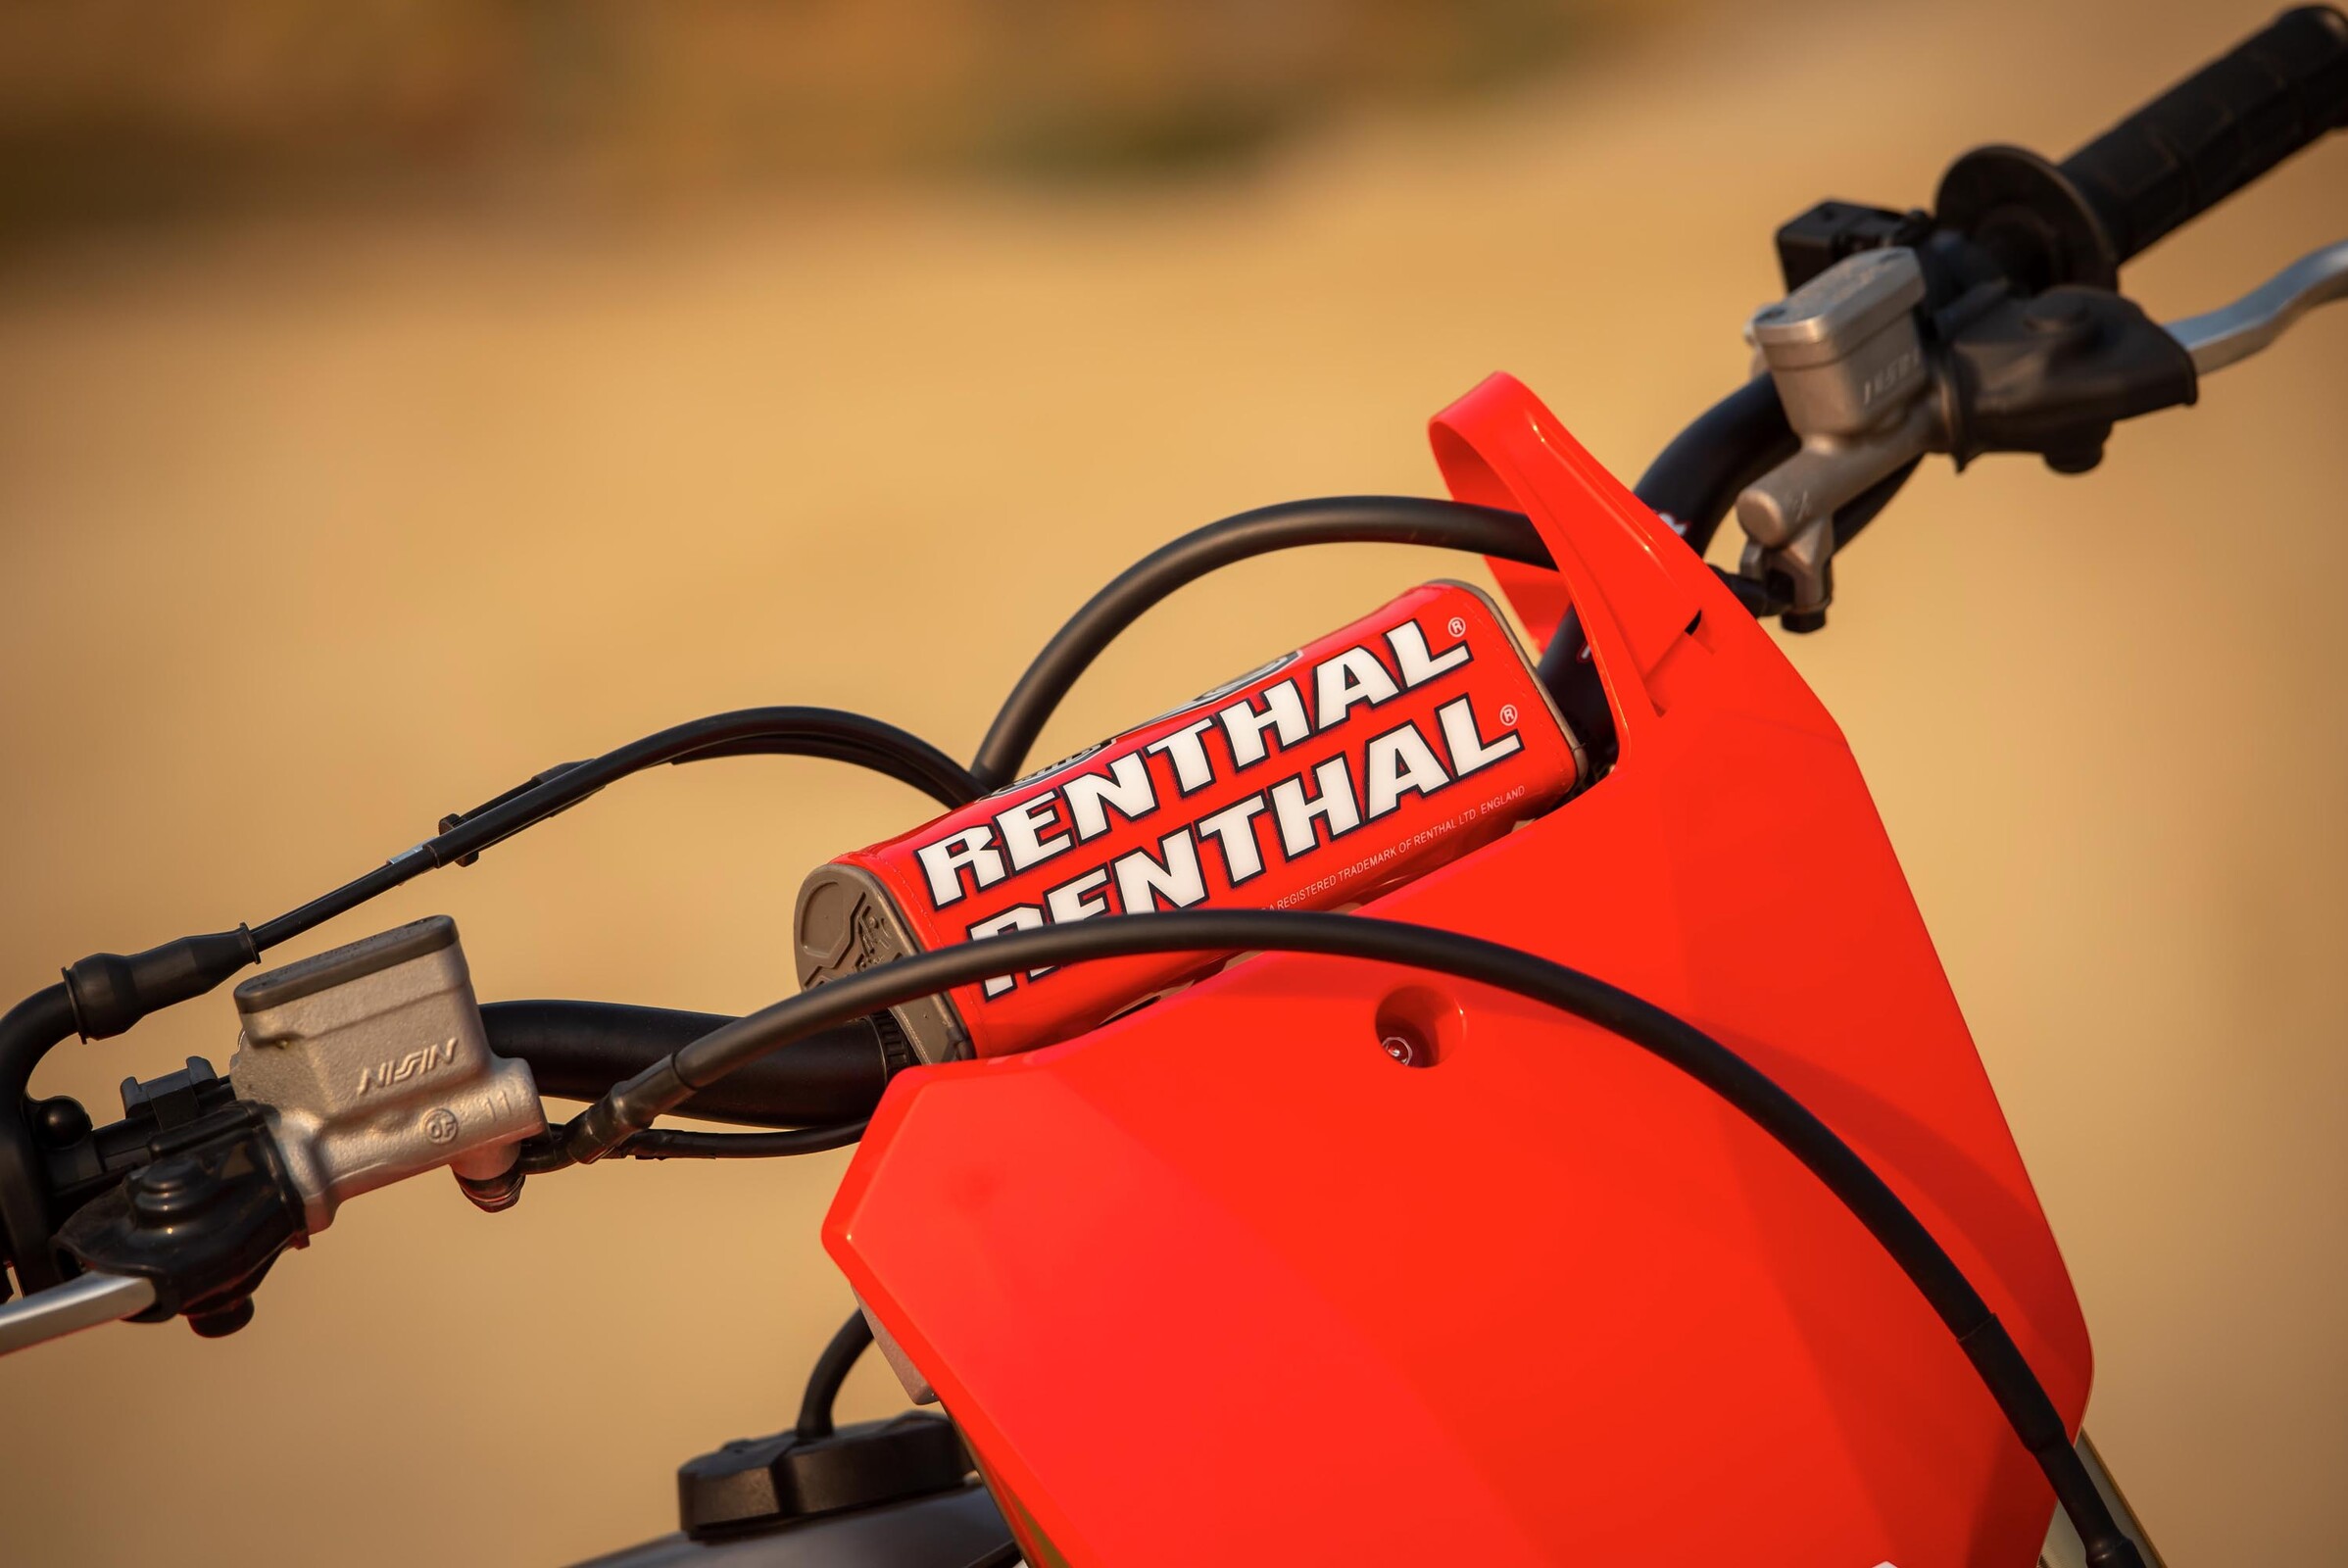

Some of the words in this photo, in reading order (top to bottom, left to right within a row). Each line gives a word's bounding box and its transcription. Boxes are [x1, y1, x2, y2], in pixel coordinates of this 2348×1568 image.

[914, 618, 1474, 909] RENTHAL
[1277, 875, 1337, 910] REGISTERED
[1338, 846, 1397, 881] TRADEMARK
[1398, 840, 1412, 855] OF
[1414, 819, 1457, 848] RENTHAL
[1480, 785, 1525, 814] ENGLAND
